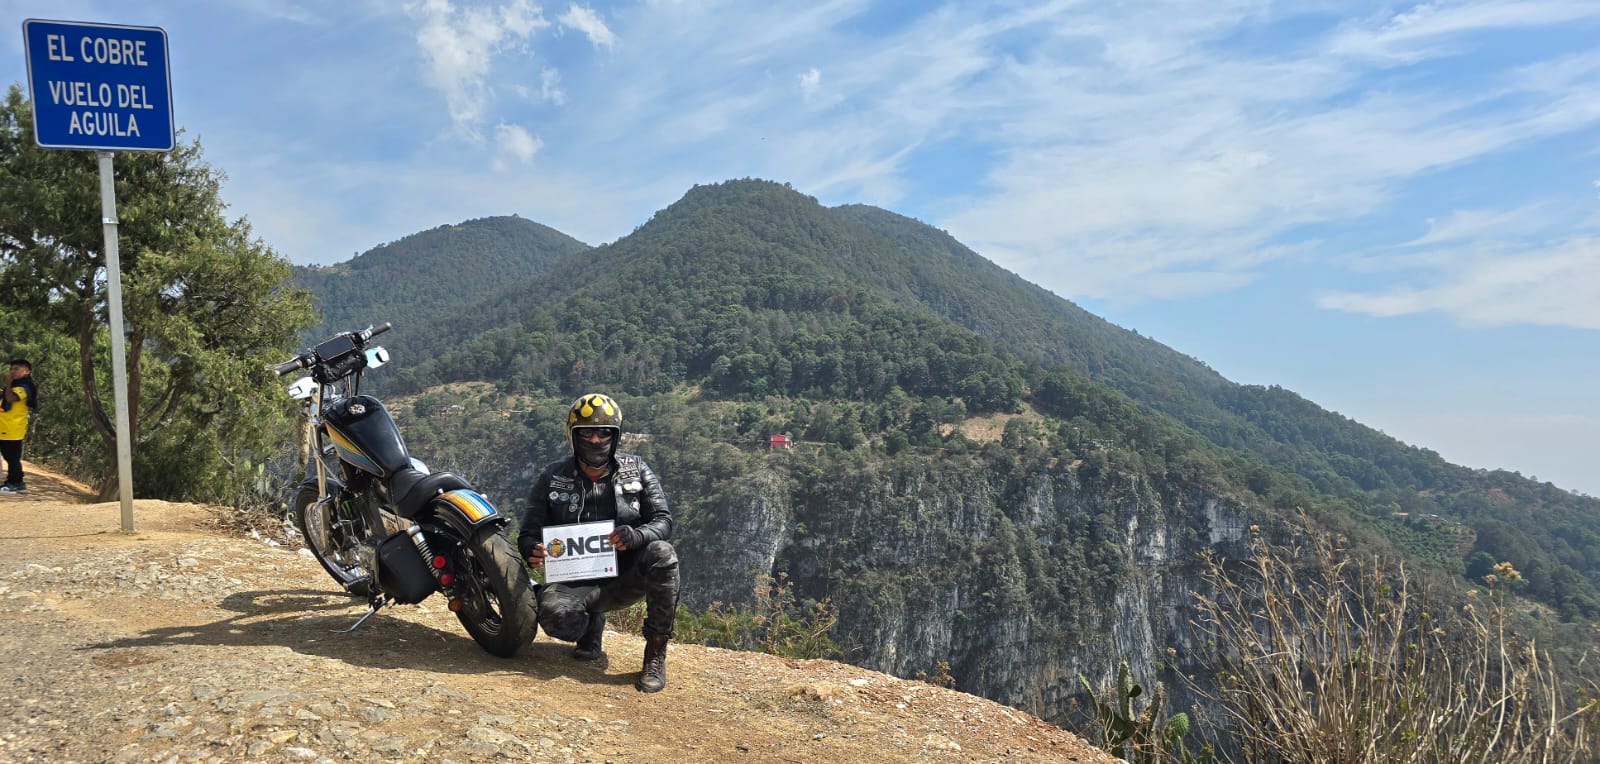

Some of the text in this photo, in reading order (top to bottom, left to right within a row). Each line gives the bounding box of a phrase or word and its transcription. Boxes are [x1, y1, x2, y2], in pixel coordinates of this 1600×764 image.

[47, 34, 148, 66] EL COBRE
[48, 80, 154, 110] VUELO DEL
[69, 111, 141, 137] AGUILA
